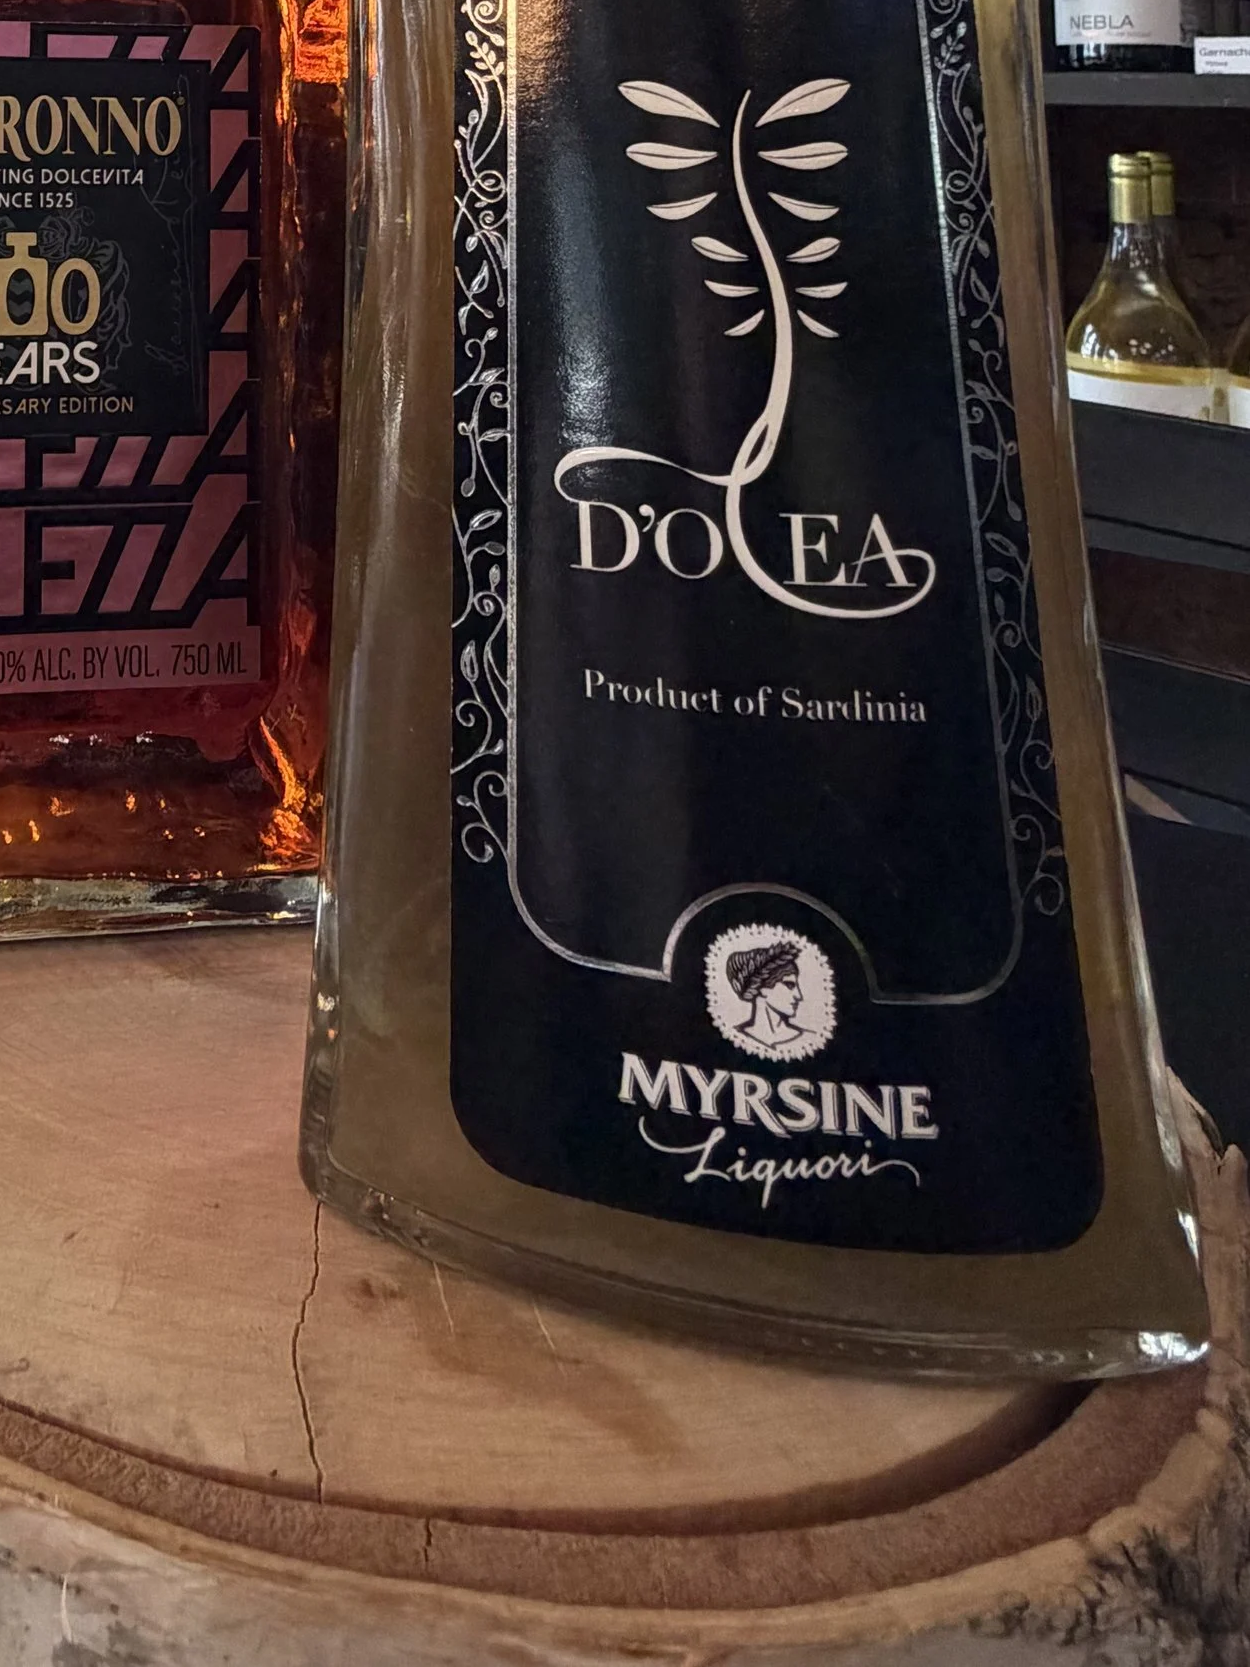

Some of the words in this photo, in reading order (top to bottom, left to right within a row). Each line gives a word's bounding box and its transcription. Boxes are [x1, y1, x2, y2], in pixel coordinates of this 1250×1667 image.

[1069, 14, 1134, 31] NEBLA
[41, 167, 144, 186] DOLCEVITA
[39, 192, 74, 209] 1525
[58, 396, 134, 415] EDITION
[32, 647, 76, 682] ALC.
[83, 646, 112, 679] BY
[113, 644, 160, 678] VOL.
[170, 644, 211, 676] 750
[216, 641, 248, 674] ML
[584, 667, 722, 715] Product
[733, 686, 773, 718] of
[780, 687, 928, 724] Sardinia
[618, 1051, 940, 1140] MYRSINE
[638, 1116, 921, 1209] Liquori
